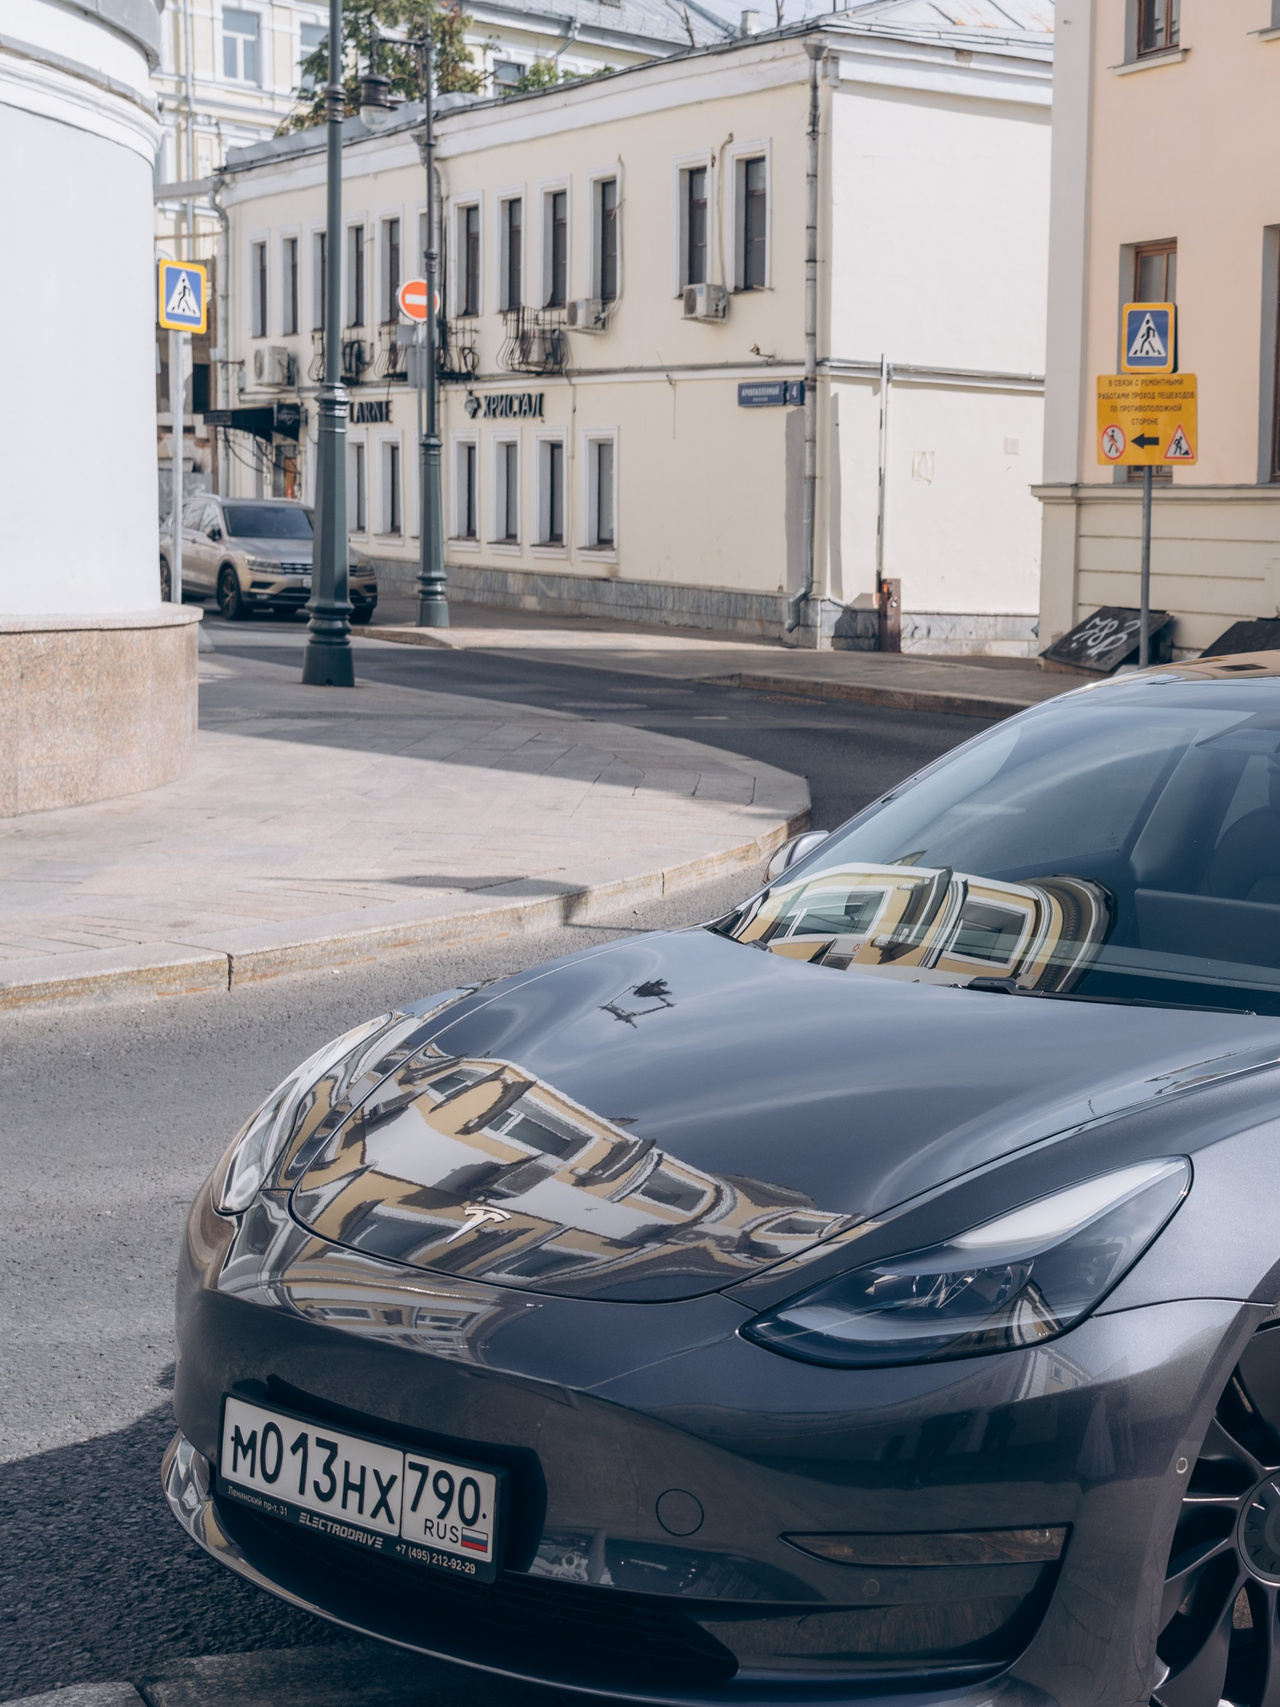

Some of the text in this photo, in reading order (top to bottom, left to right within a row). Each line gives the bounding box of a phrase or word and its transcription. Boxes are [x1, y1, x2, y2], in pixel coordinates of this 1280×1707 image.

[791, 385, 797, 398] 4
[1098, 391, 1195, 400] РАБОТАМИ ПРОХОД ПЕШЕХОДОВ
[1114, 379, 1133, 387] СВЯЗИ
[1135, 379, 1139, 387] С
[1141, 378, 1184, 387] РЕМОНТНЫМИ
[1110, 403, 1183, 413] ПО ПРОТИВОПОЛОЖНОЙ
[228, 1486, 288, 1516] Ленинский пр-т, 31
[408, 1460, 481, 1527] 790
[299, 1512, 384, 1549] ELECTRODRIVE
[424, 1518, 459, 1544] RUS
[396, 1544, 476, 1575] +7 (495) 212-92-29
